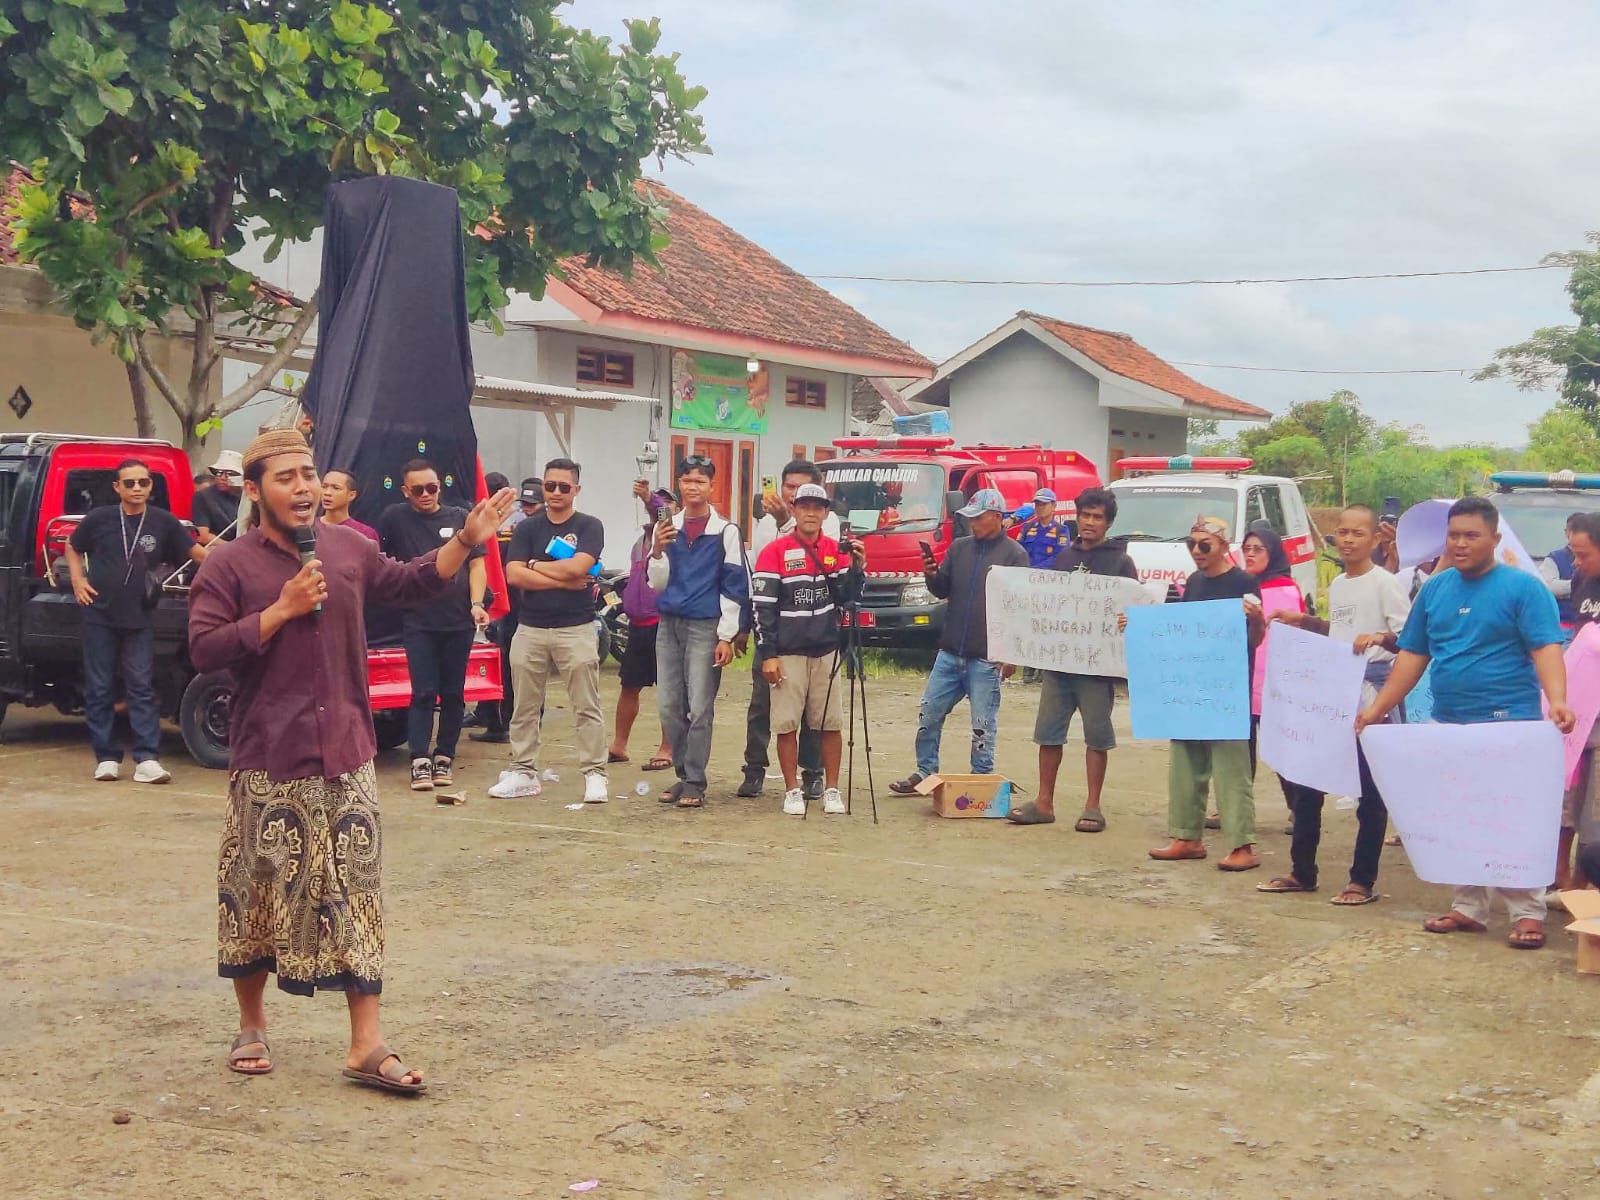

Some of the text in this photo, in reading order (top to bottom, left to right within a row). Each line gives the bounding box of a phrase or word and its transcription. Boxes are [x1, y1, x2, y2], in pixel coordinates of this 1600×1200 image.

[825, 468, 919, 483] DAMKAR CIANJUR
[1029, 571, 1072, 584] GANTI
[1031, 619, 1092, 635] DENGAN
